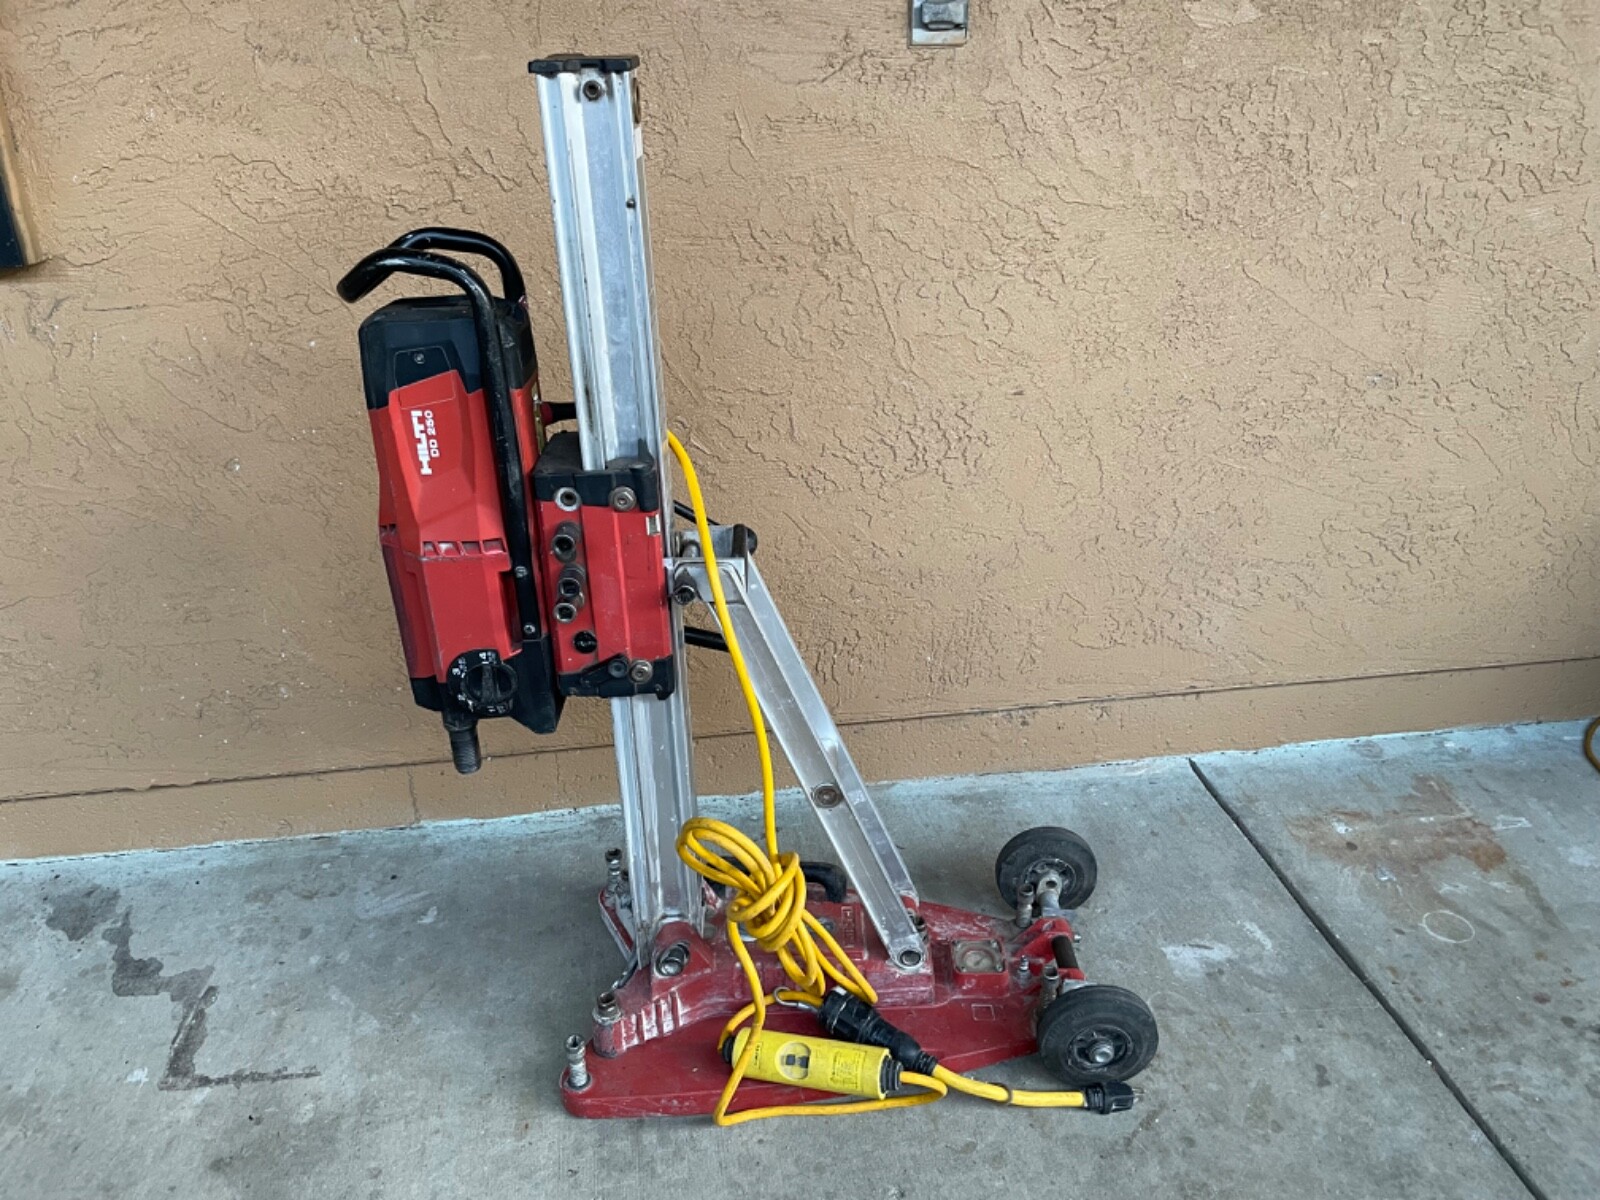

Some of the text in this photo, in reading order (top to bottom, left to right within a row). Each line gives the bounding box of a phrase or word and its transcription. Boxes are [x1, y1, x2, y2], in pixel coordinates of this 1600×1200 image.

[410, 410, 433, 475] HILTI
[424, 410, 440, 457] DD 250
